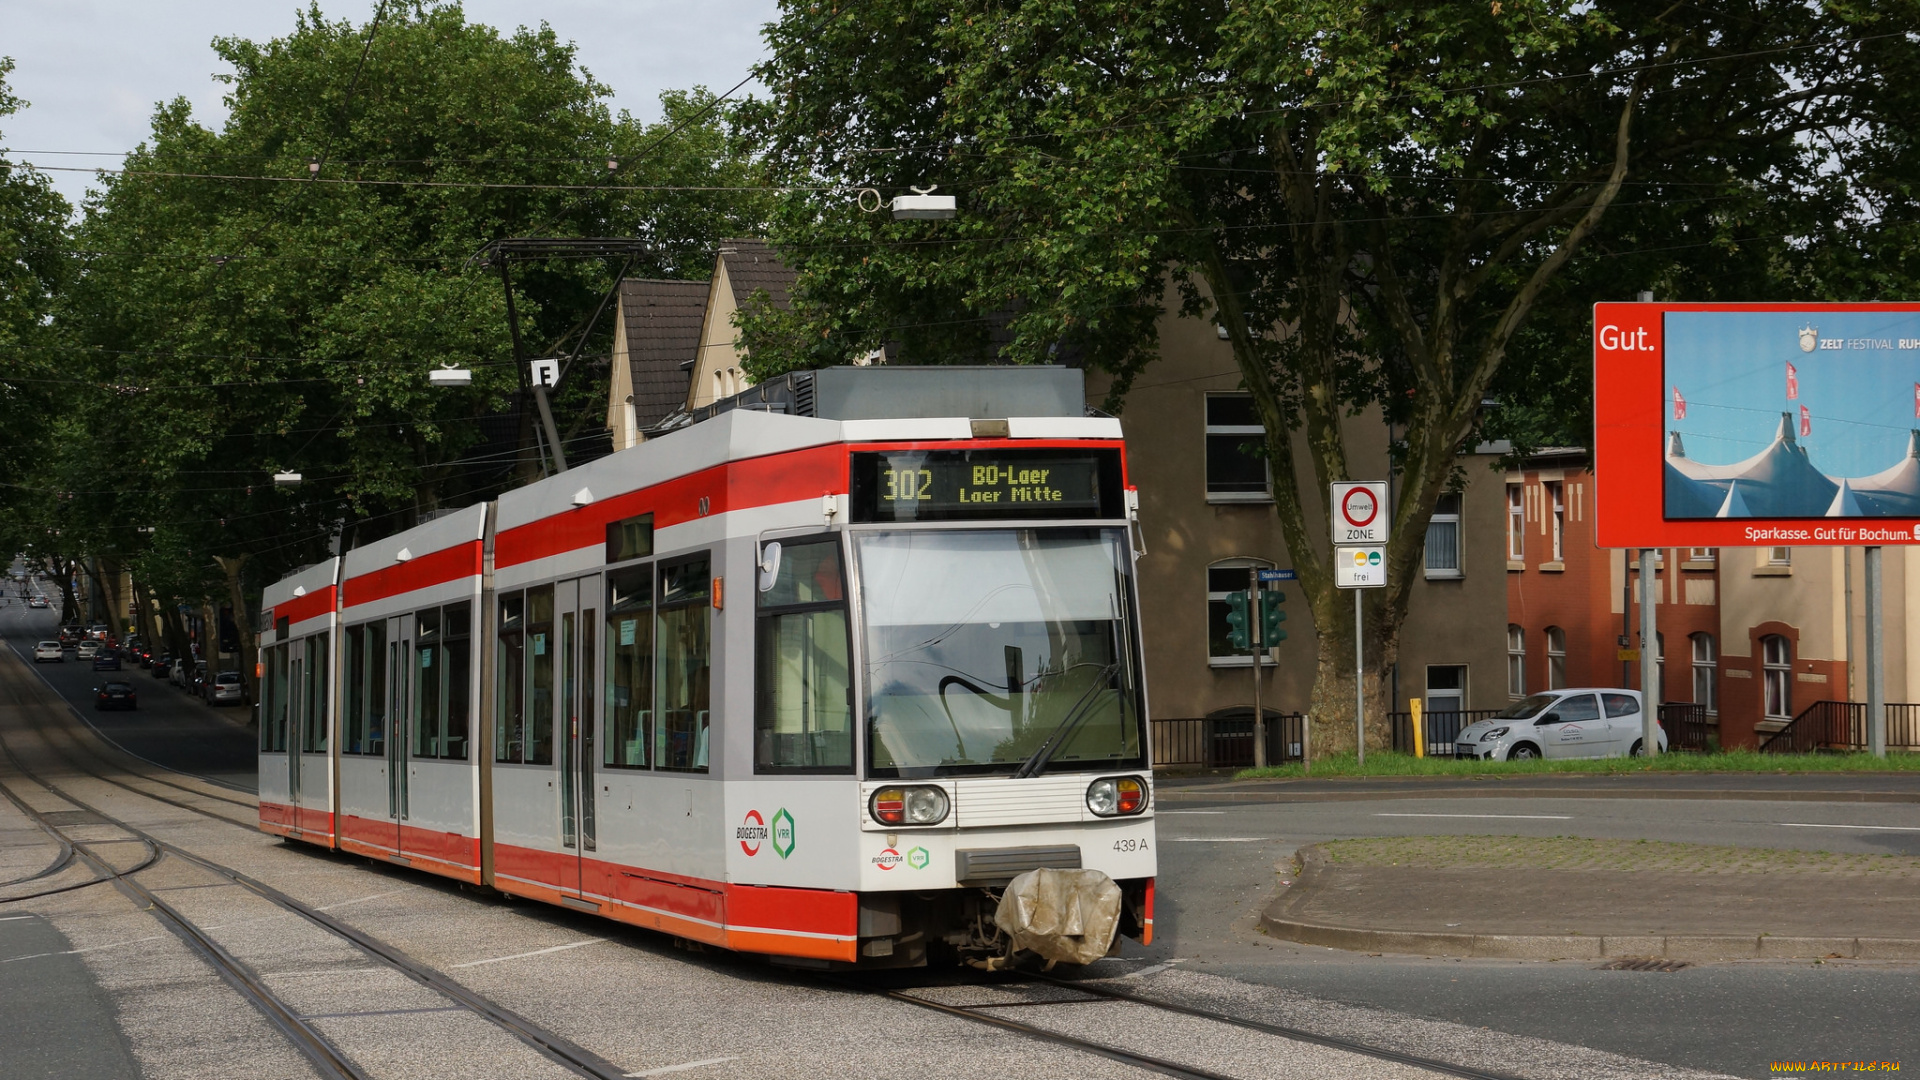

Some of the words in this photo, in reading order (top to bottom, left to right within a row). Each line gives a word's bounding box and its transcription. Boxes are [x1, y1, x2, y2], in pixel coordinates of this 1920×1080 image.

[1599, 324, 1655, 351] Gut.
[1820, 339, 1844, 350] ZELT
[1847, 339, 1894, 350] FESTIVAL
[1899, 339, 1920, 350] RUH
[540, 366, 551, 387] E
[883, 469, 932, 501] 302
[972, 465, 1050, 485] BO-Laer
[959, 488, 1002, 503] Laer
[1011, 486, 1062, 502] Mitte
[1347, 503, 1373, 511] Umwelt
[1347, 529, 1374, 540] ZONE
[1745, 527, 1811, 541] Sparkasse.
[1814, 528, 1836, 540] Gut
[1838, 528, 1857, 540] für
[1859, 528, 1911, 540] Bochum.
[1353, 572, 1369, 581] frei
[736, 827, 768, 839] BOGESTRA
[777, 828, 790, 839] VRR
[1112, 839, 1136, 852] 439
[1139, 838, 1149, 851] A
[871, 856, 904, 864] BOGESTRA
